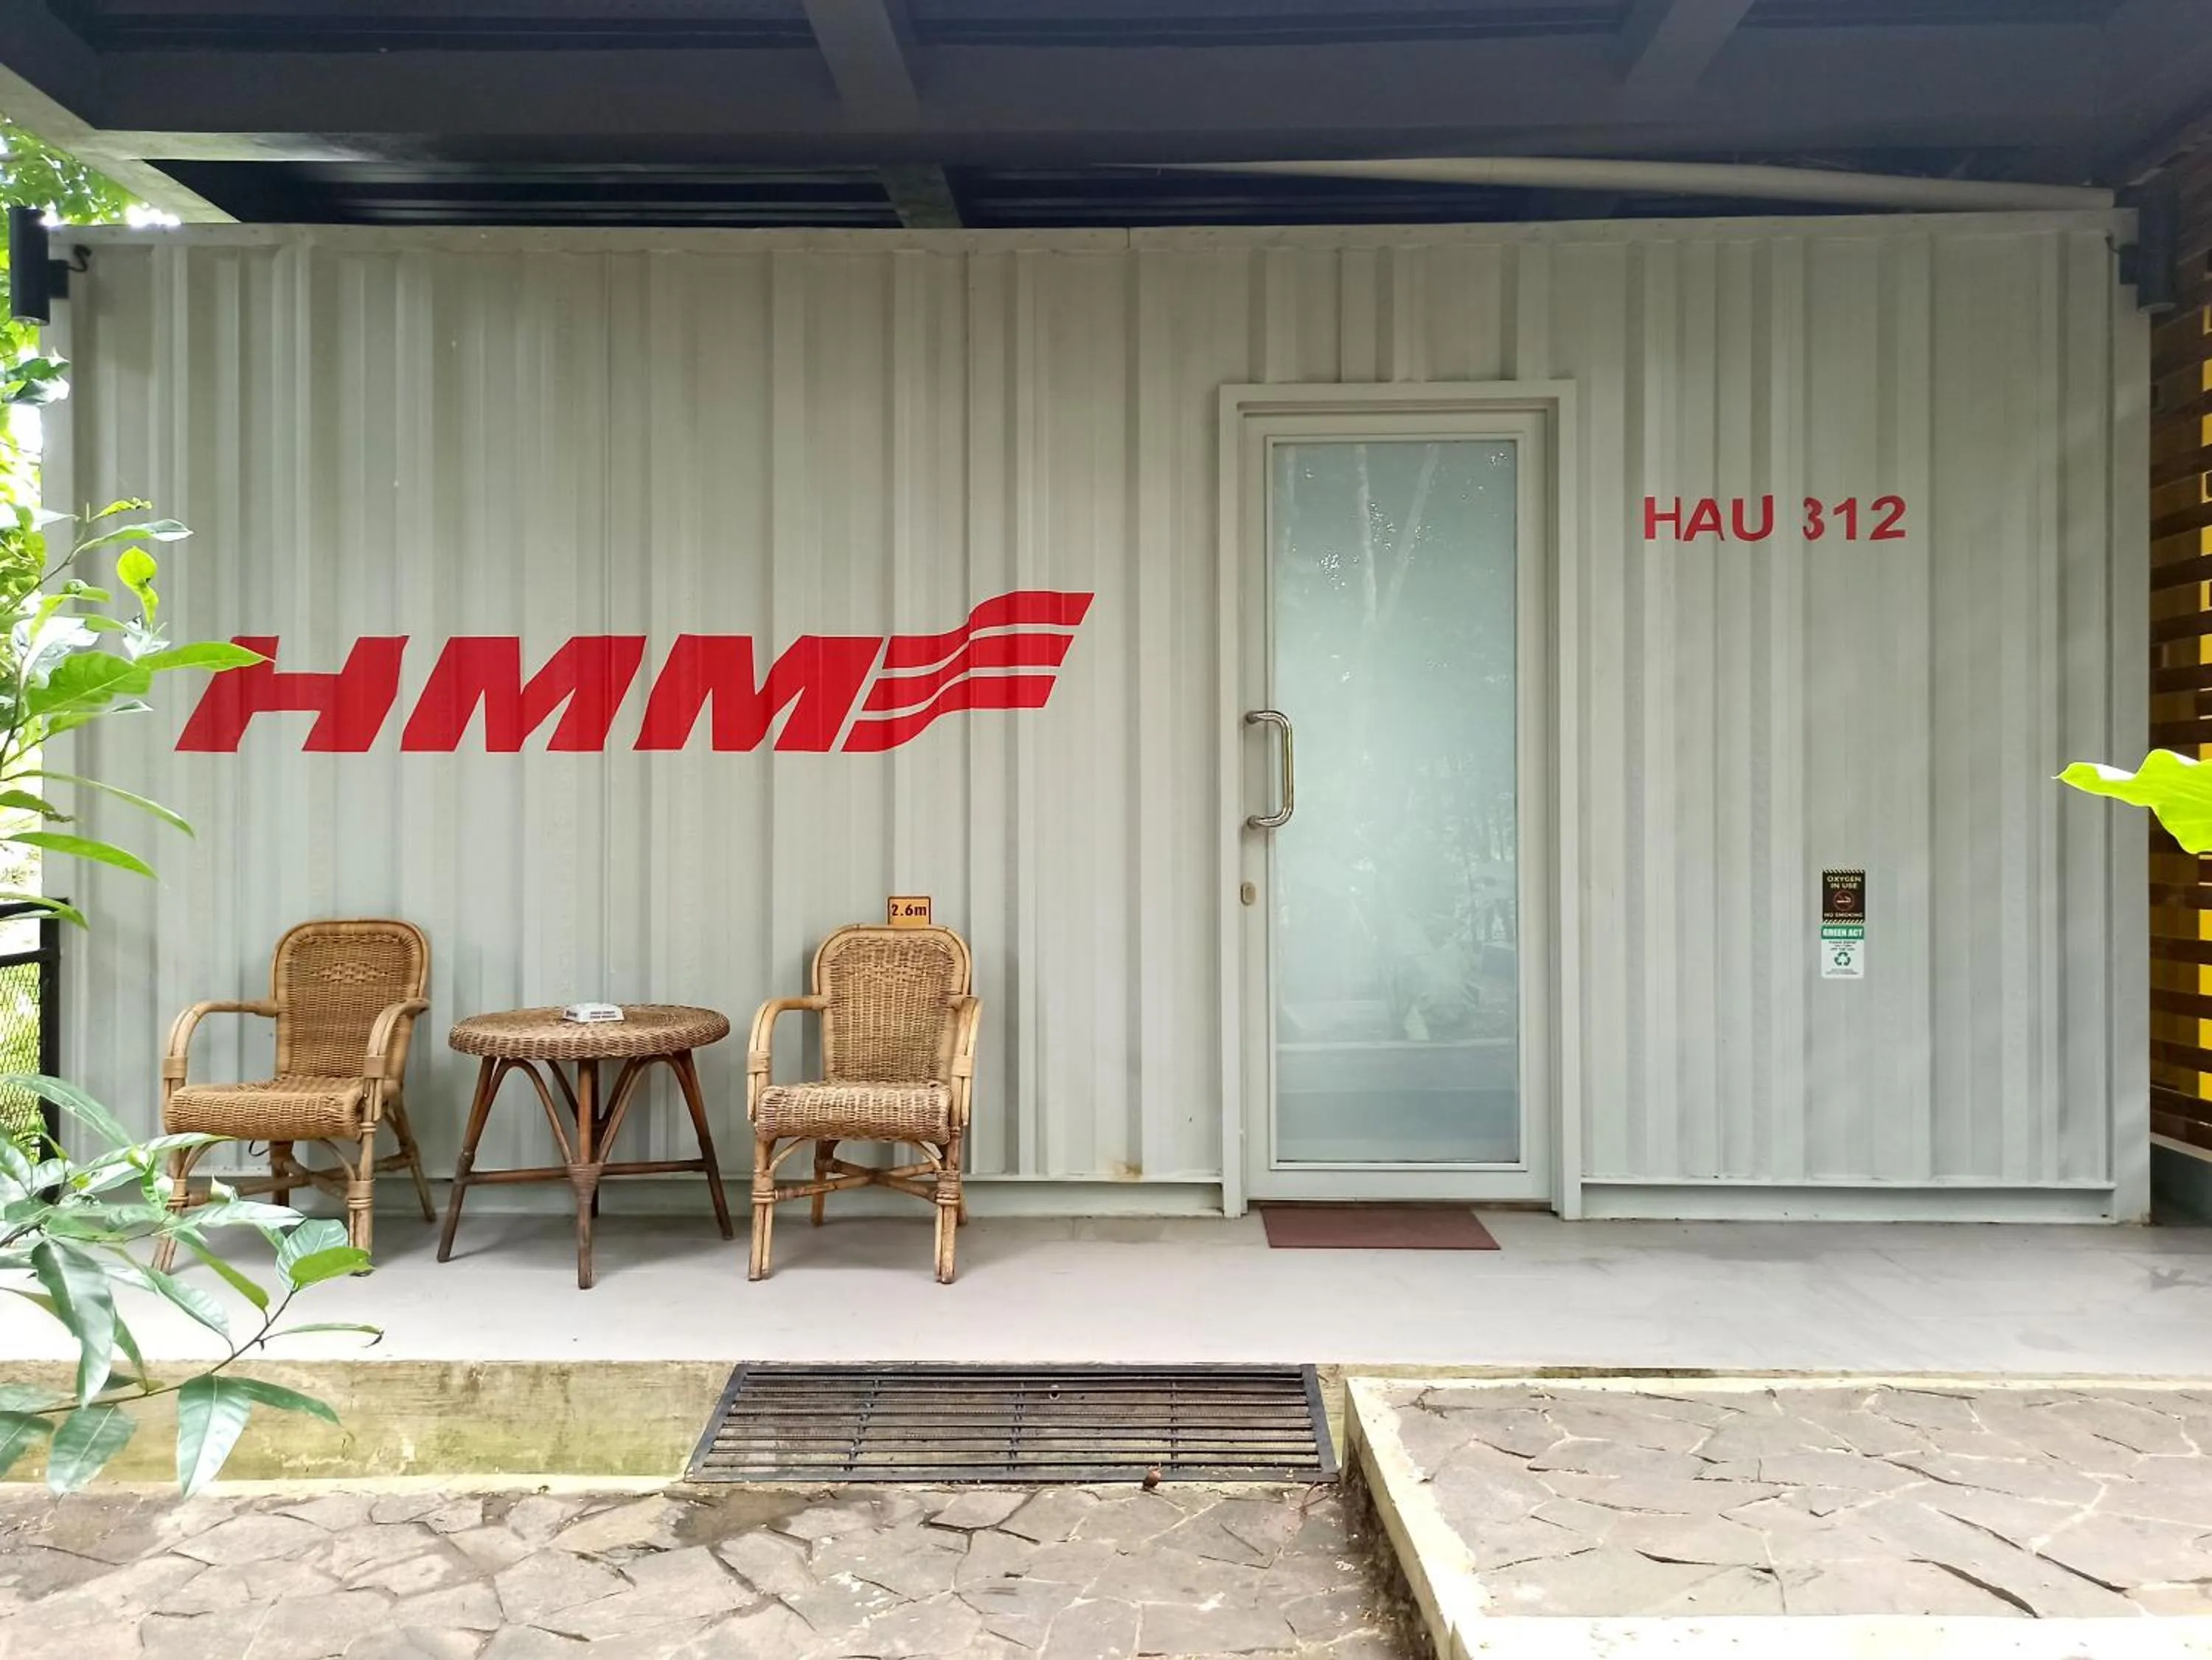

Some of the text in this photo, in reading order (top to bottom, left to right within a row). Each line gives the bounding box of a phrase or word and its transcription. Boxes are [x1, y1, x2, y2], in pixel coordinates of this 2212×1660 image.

[1644, 495, 1907, 543] HAU 312
[174, 634, 883, 752] HMM
[891, 904, 927, 916] 2.6m
[1822, 928, 1863, 938] GREEN ACT
